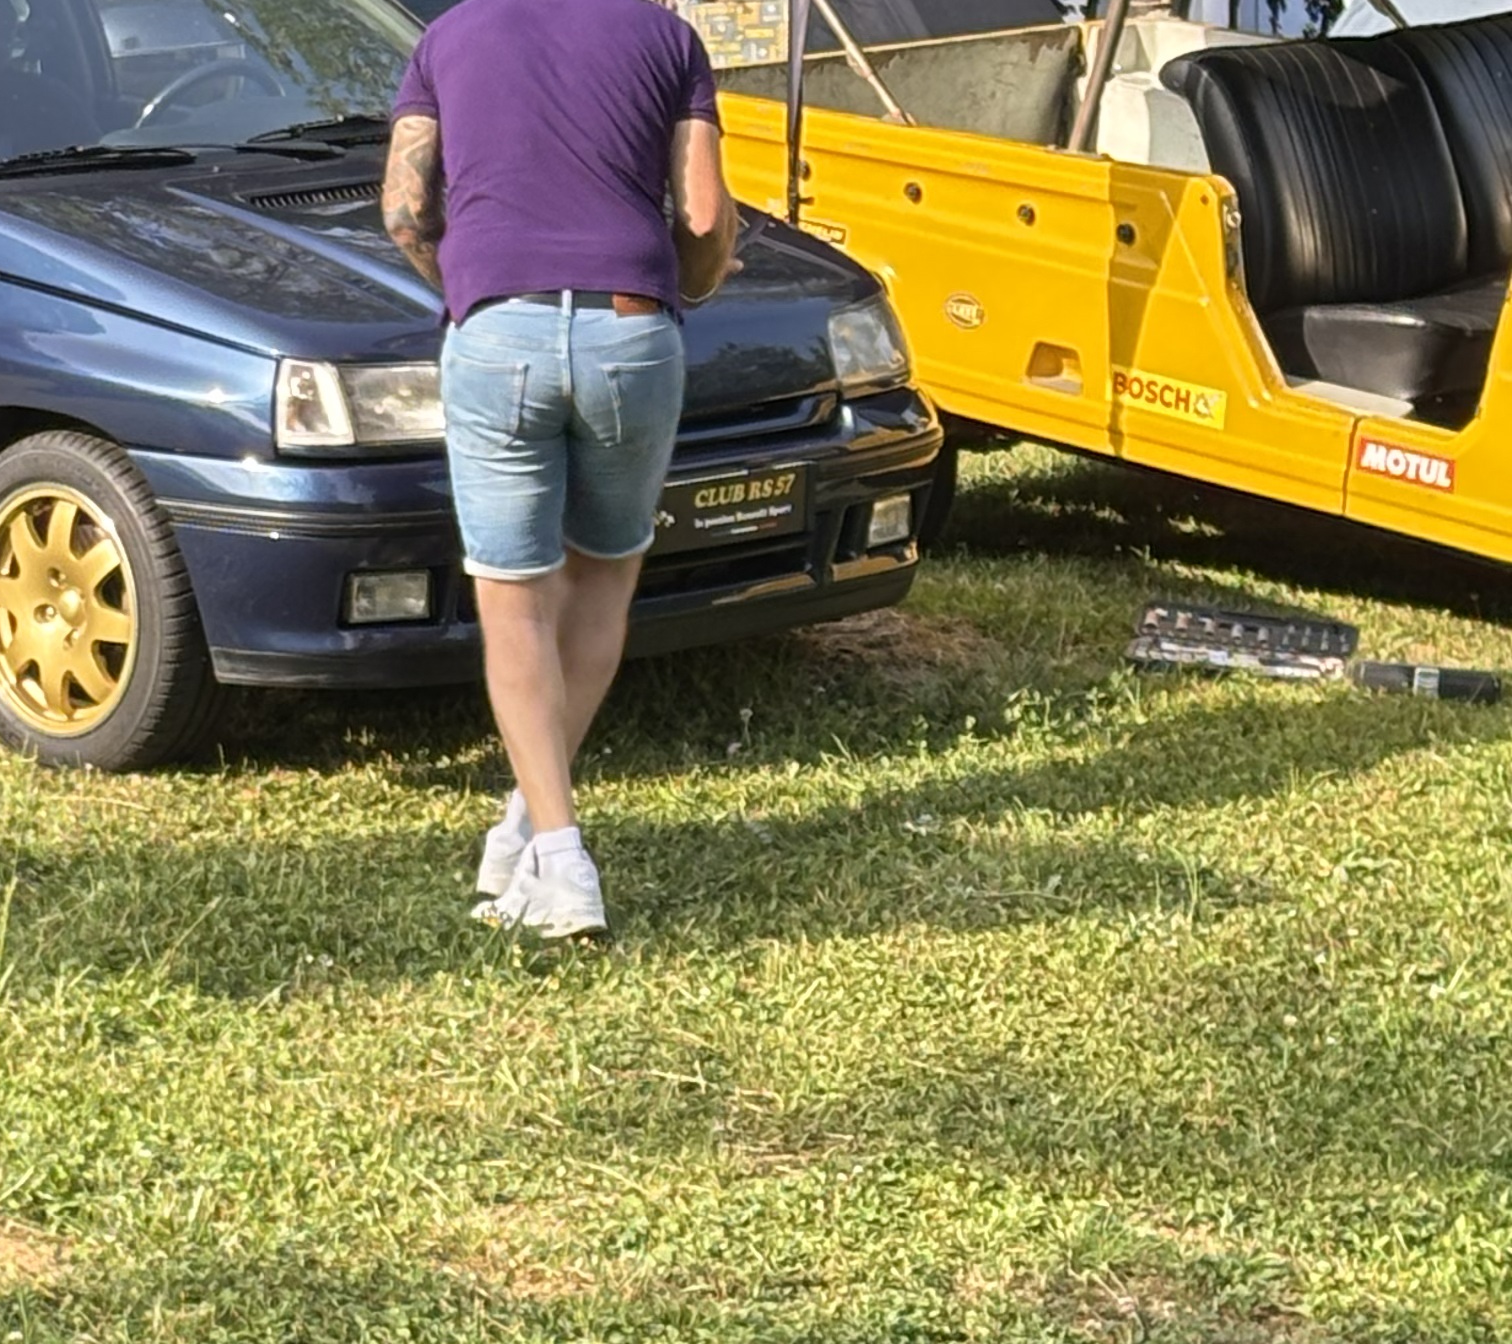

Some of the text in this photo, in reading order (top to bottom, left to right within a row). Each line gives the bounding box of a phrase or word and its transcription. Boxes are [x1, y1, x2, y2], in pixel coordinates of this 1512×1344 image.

[1111, 371, 1192, 414] BOSCH
[1360, 441, 1452, 490] MOTUL
[694, 473, 796, 508] CLUB RS 57
